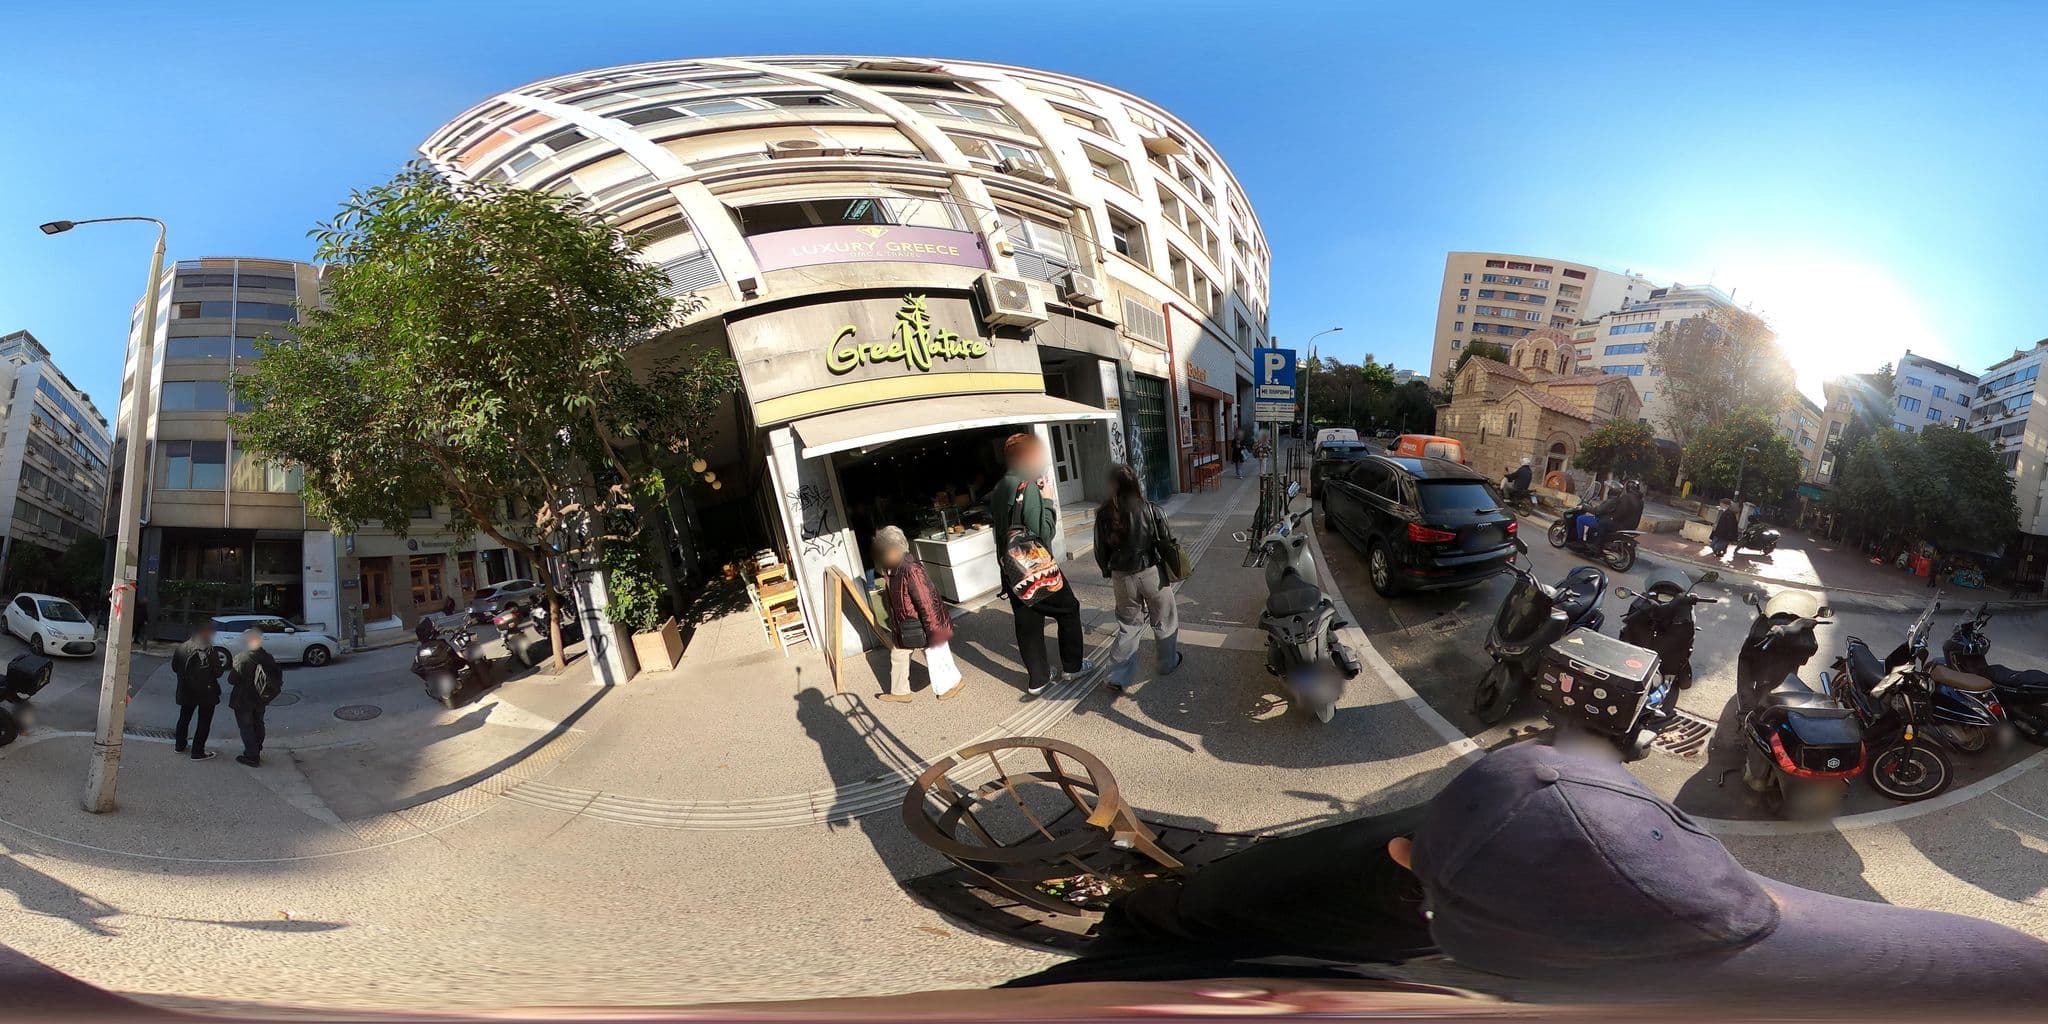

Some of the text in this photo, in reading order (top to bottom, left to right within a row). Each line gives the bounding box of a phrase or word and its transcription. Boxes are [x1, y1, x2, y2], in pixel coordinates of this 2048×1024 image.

[791, 240, 960, 257] LUXURY GREECE
[1264, 352, 1286, 384] P
